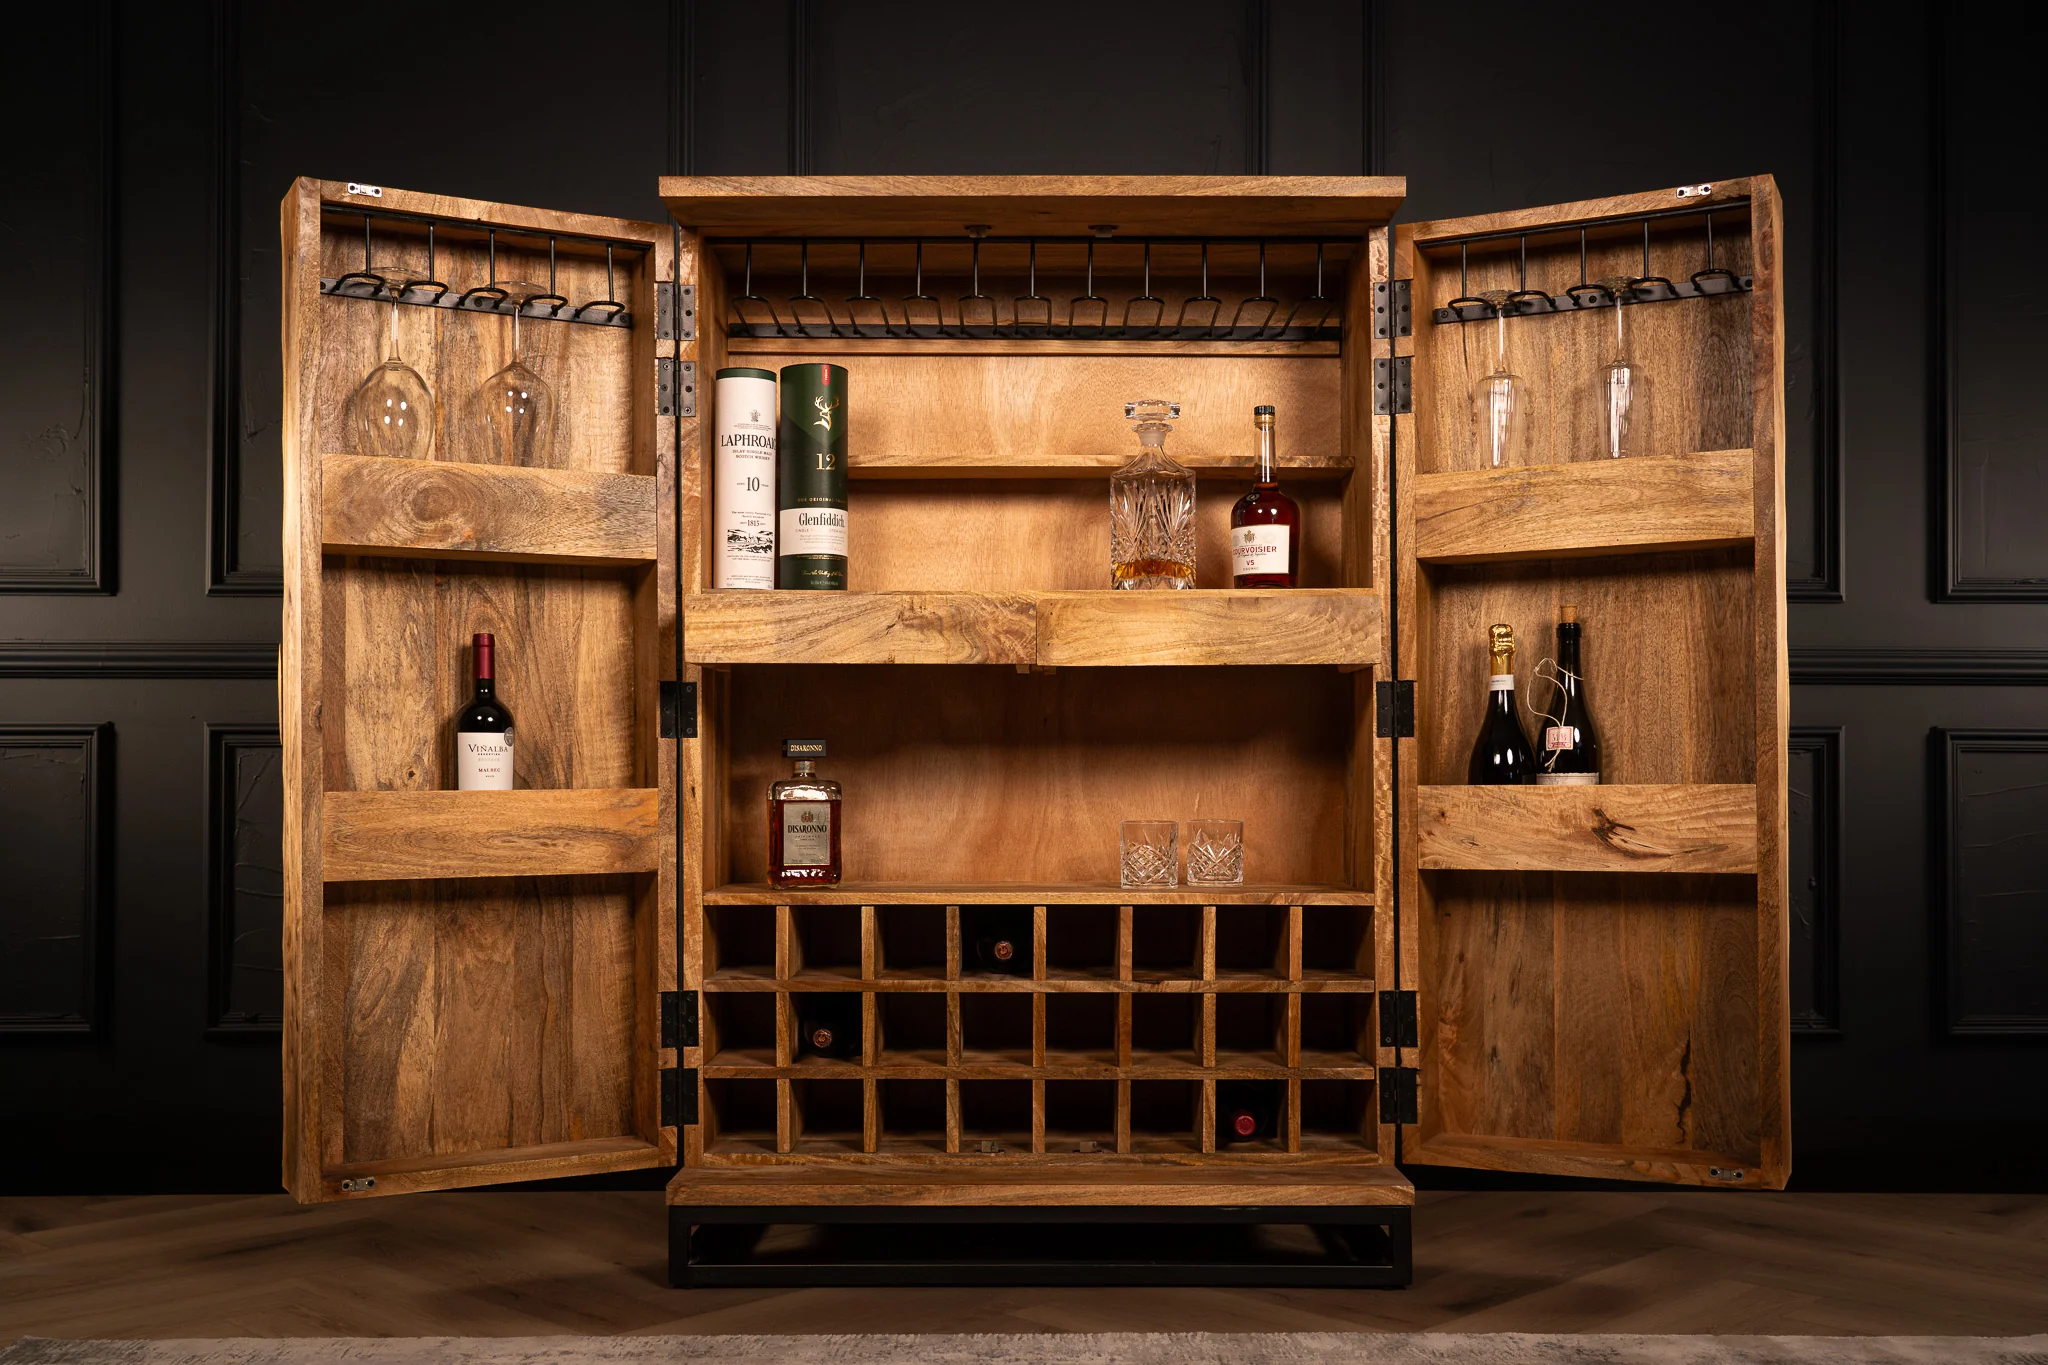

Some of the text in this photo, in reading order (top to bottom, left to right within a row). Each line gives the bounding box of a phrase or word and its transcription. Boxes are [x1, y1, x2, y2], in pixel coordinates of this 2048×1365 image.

[816, 453, 836, 471] 12
[746, 476, 760, 492] 10
[747, 519, 760, 527] 1815
[798, 512, 846, 528] Glenfiddich
[790, 744, 822, 752] DISARONNO
[787, 824, 827, 833] DISARONNO
